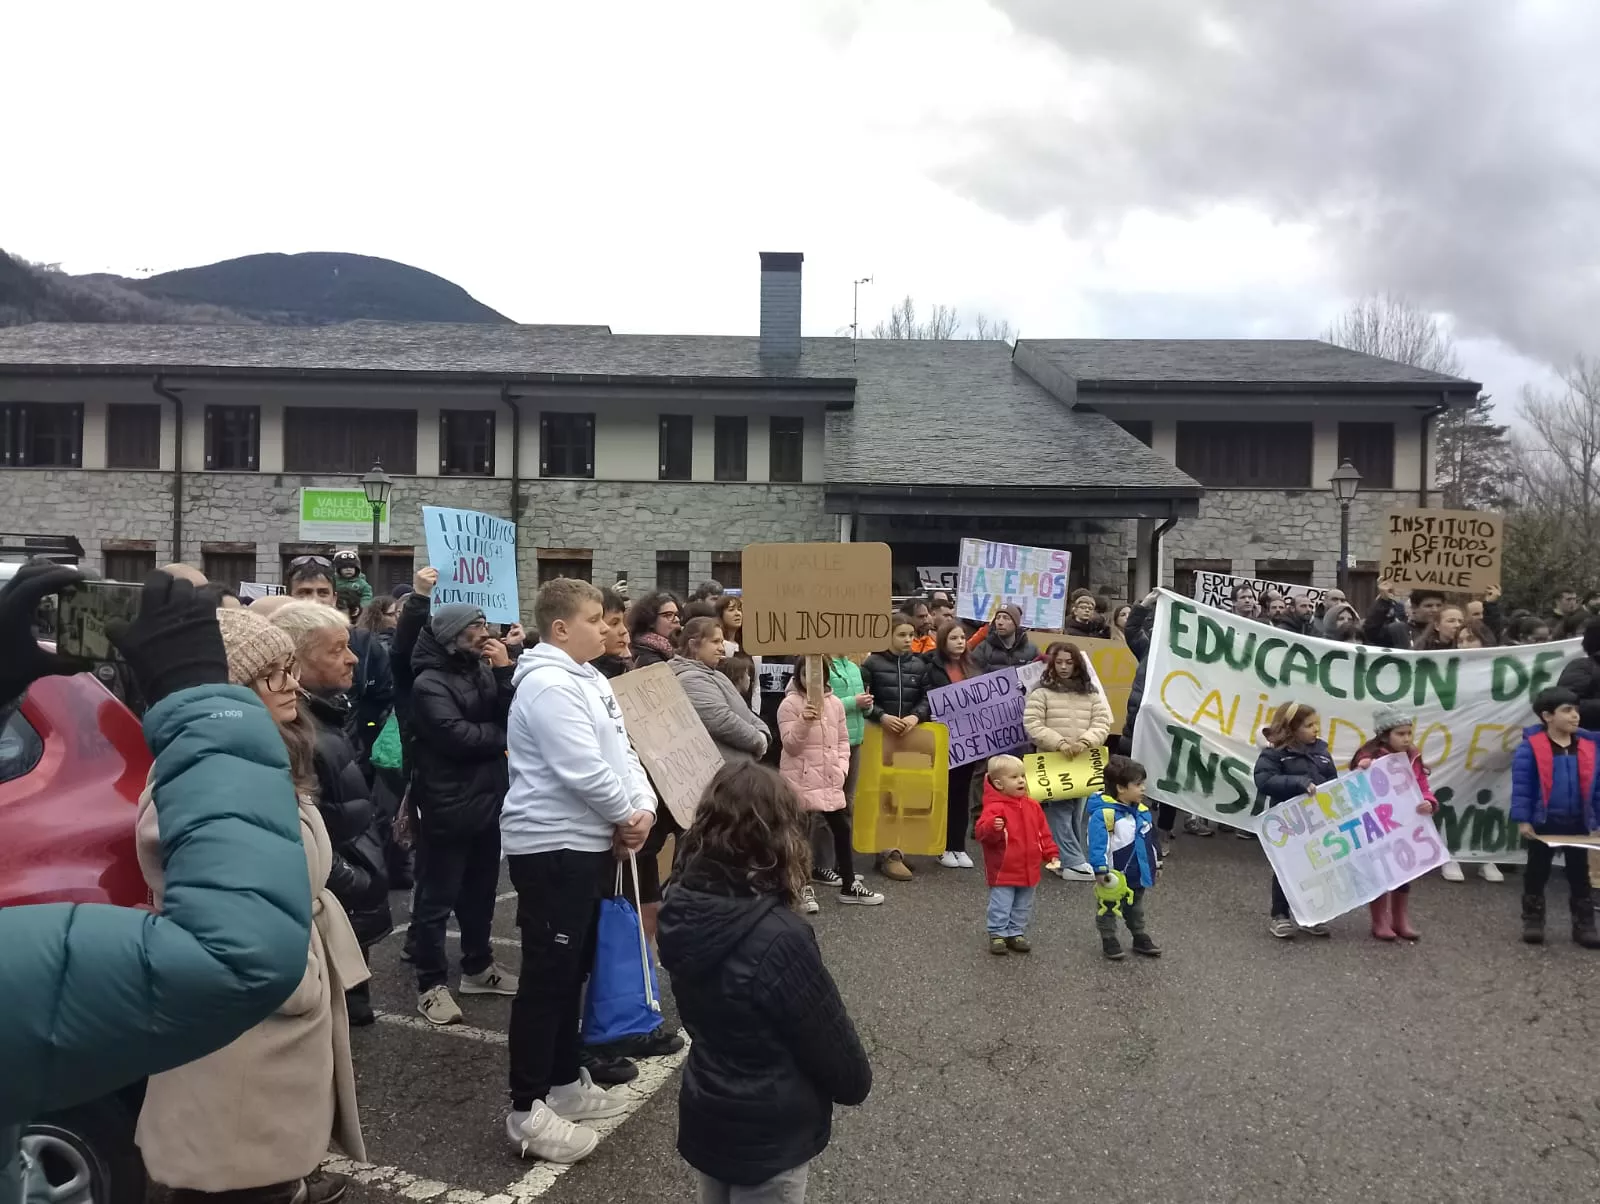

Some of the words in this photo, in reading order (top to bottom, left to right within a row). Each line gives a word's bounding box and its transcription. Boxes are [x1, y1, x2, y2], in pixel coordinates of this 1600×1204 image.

[317, 496, 354, 508] VALLE
[1390, 516, 1494, 538] INSTITUTO
[1412, 534, 1438, 550] DE
[966, 542, 1066, 573] JUNTOS
[1390, 548, 1492, 568] INSTITUTO
[960, 566, 1066, 600] HACEMOS
[1383, 567, 1412, 582] DEL
[1416, 570, 1472, 587] VALLE
[973, 594, 1051, 626] VALE
[756, 611, 786, 644] UN
[796, 611, 890, 640] INSTITUTO
[1493, 651, 1564, 702] DE
[932, 692, 954, 717] LA
[955, 676, 1010, 708] UNIDAD
[948, 718, 965, 738] EL
[967, 696, 1026, 734] INSTITUTO
[949, 744, 966, 766] NO
[966, 736, 984, 756] SE
[985, 724, 1028, 751] NEGOCI
[1058, 772, 1074, 792] UN
[1156, 724, 1256, 815] INS
[1262, 759, 1414, 848] QUEREMOS
[1305, 803, 1403, 872] ESTAR
[1299, 826, 1441, 912] JUNTOS
